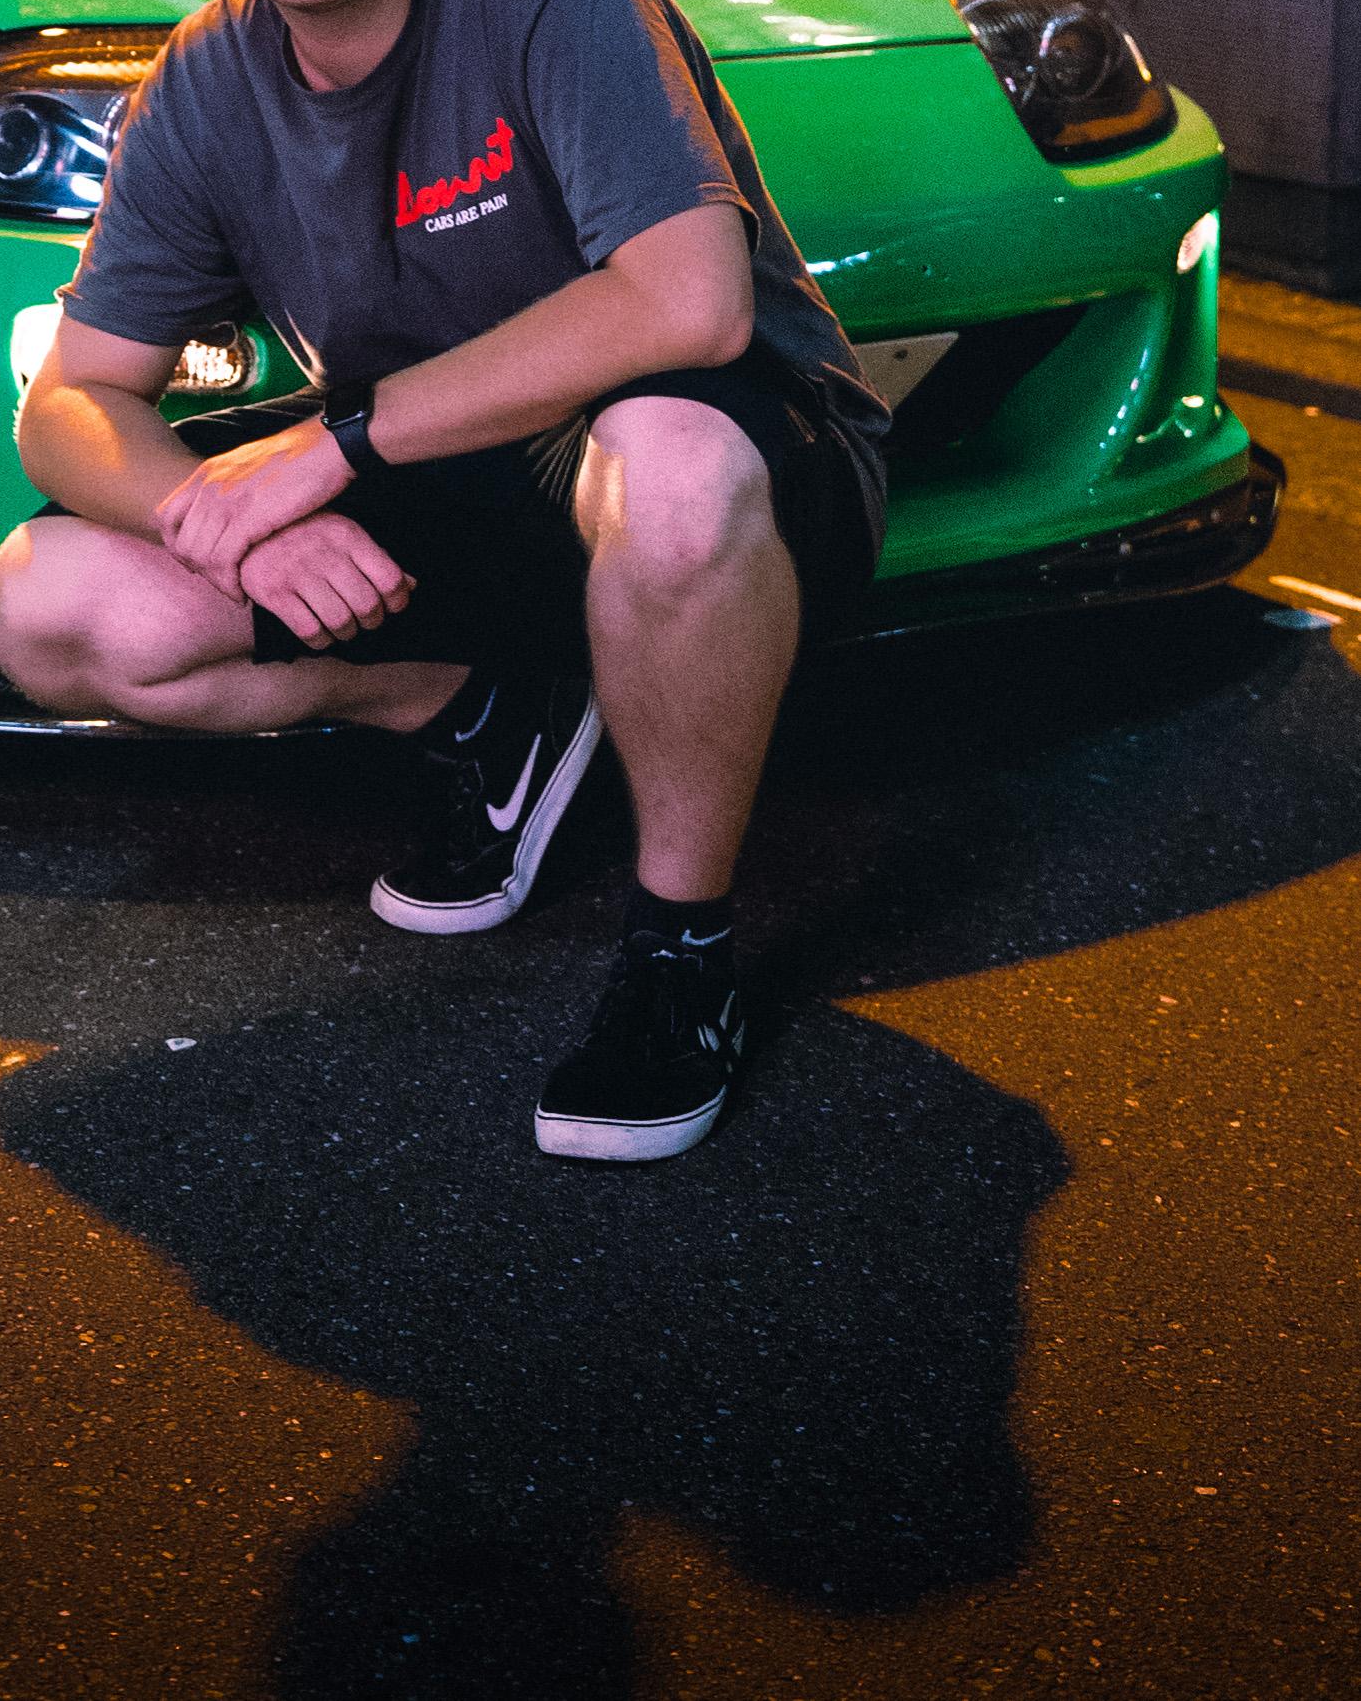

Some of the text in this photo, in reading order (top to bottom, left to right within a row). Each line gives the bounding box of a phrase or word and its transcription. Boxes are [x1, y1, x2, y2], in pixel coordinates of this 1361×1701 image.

[425, 193, 508, 233] CARS ARE PAIN
